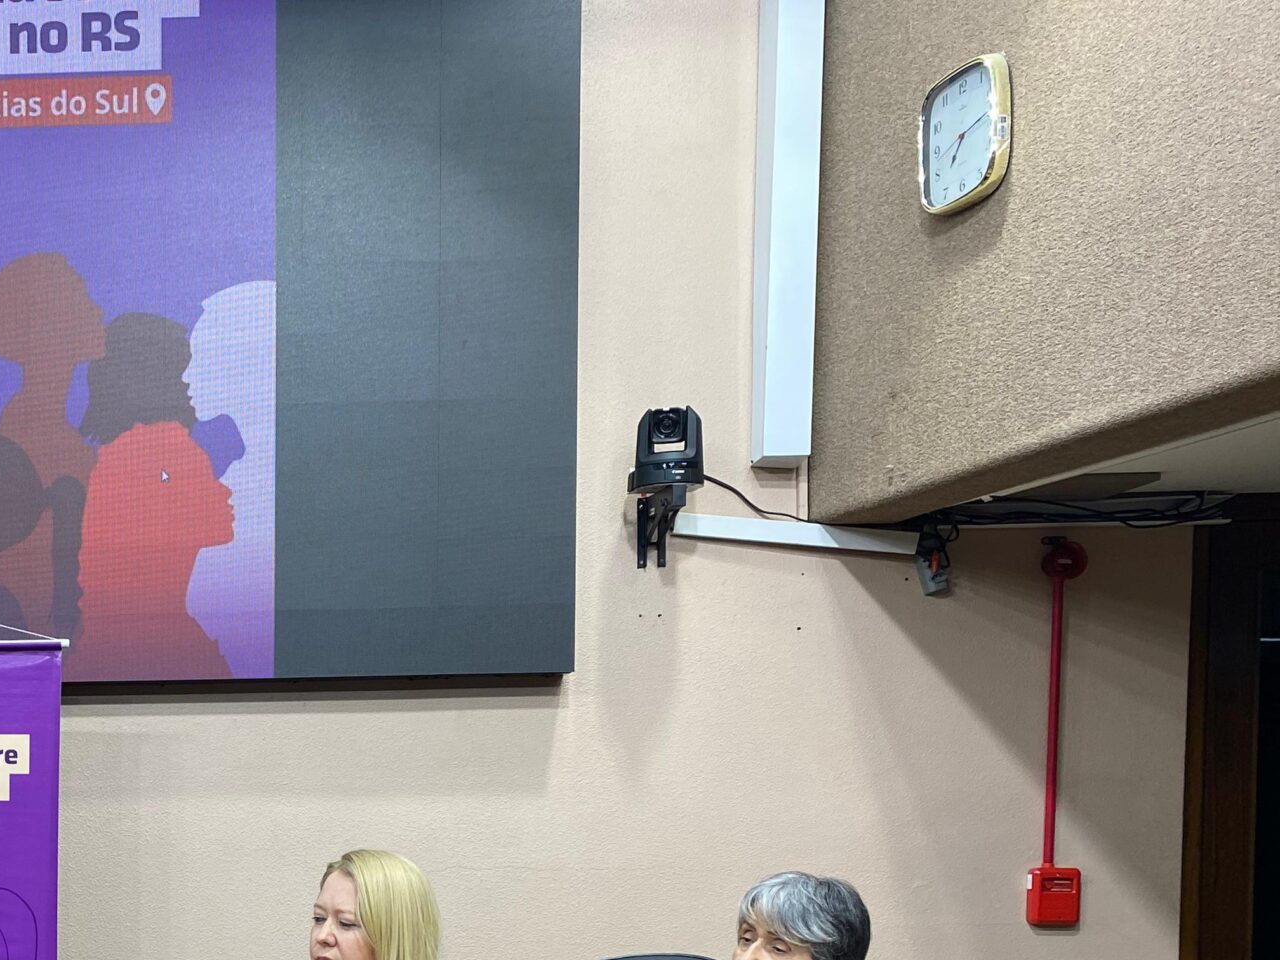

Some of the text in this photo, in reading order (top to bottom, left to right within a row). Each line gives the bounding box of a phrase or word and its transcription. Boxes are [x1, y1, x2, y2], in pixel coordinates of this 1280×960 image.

[9, 21, 69, 54] no
[81, 10, 141, 52] RS
[50, 89, 87, 117] do
[95, 87, 138, 114] Sul
